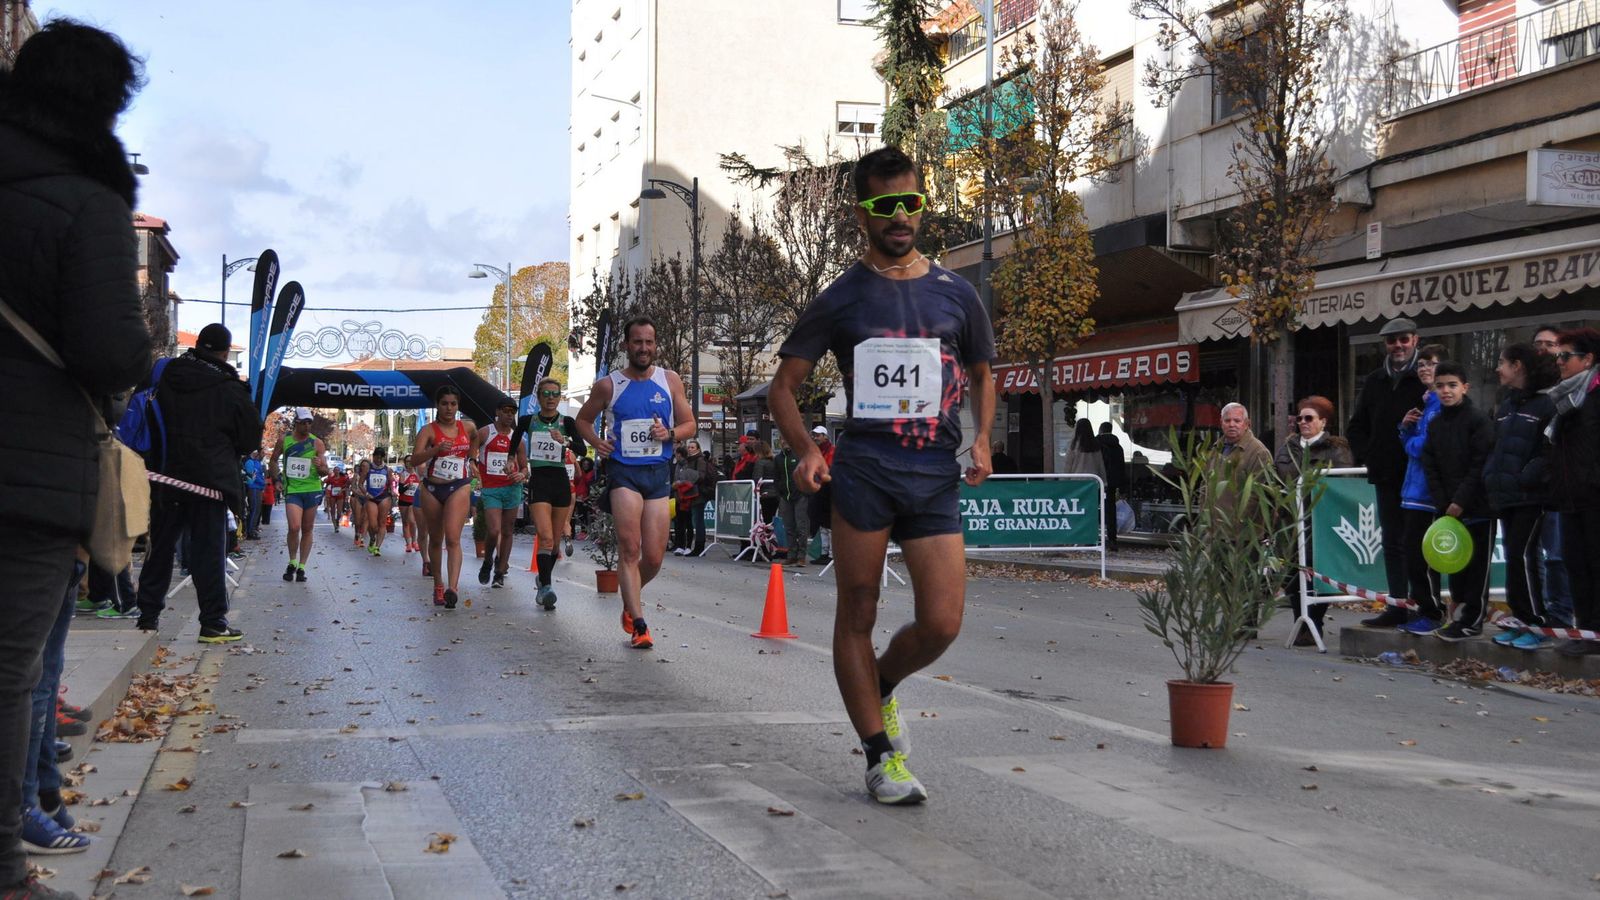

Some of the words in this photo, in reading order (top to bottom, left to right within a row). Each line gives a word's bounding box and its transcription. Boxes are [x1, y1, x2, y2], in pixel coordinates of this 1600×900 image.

[1390, 265, 1510, 306] GAZQUEZ
[1523, 252, 1600, 289] BRAV
[253, 261, 278, 360] POWERADE
[267, 292, 302, 380] POWERADE
[873, 363, 920, 388] 641
[314, 382, 421, 397] POWERADE
[630, 431, 654, 443] 664
[537, 441, 555, 452] 728
[291, 463, 306, 472] 648
[441, 460, 459, 472] 678
[1012, 498, 1085, 515] RURAL
[968, 518, 989, 531] DE
[994, 517, 1072, 530] GRANADA
